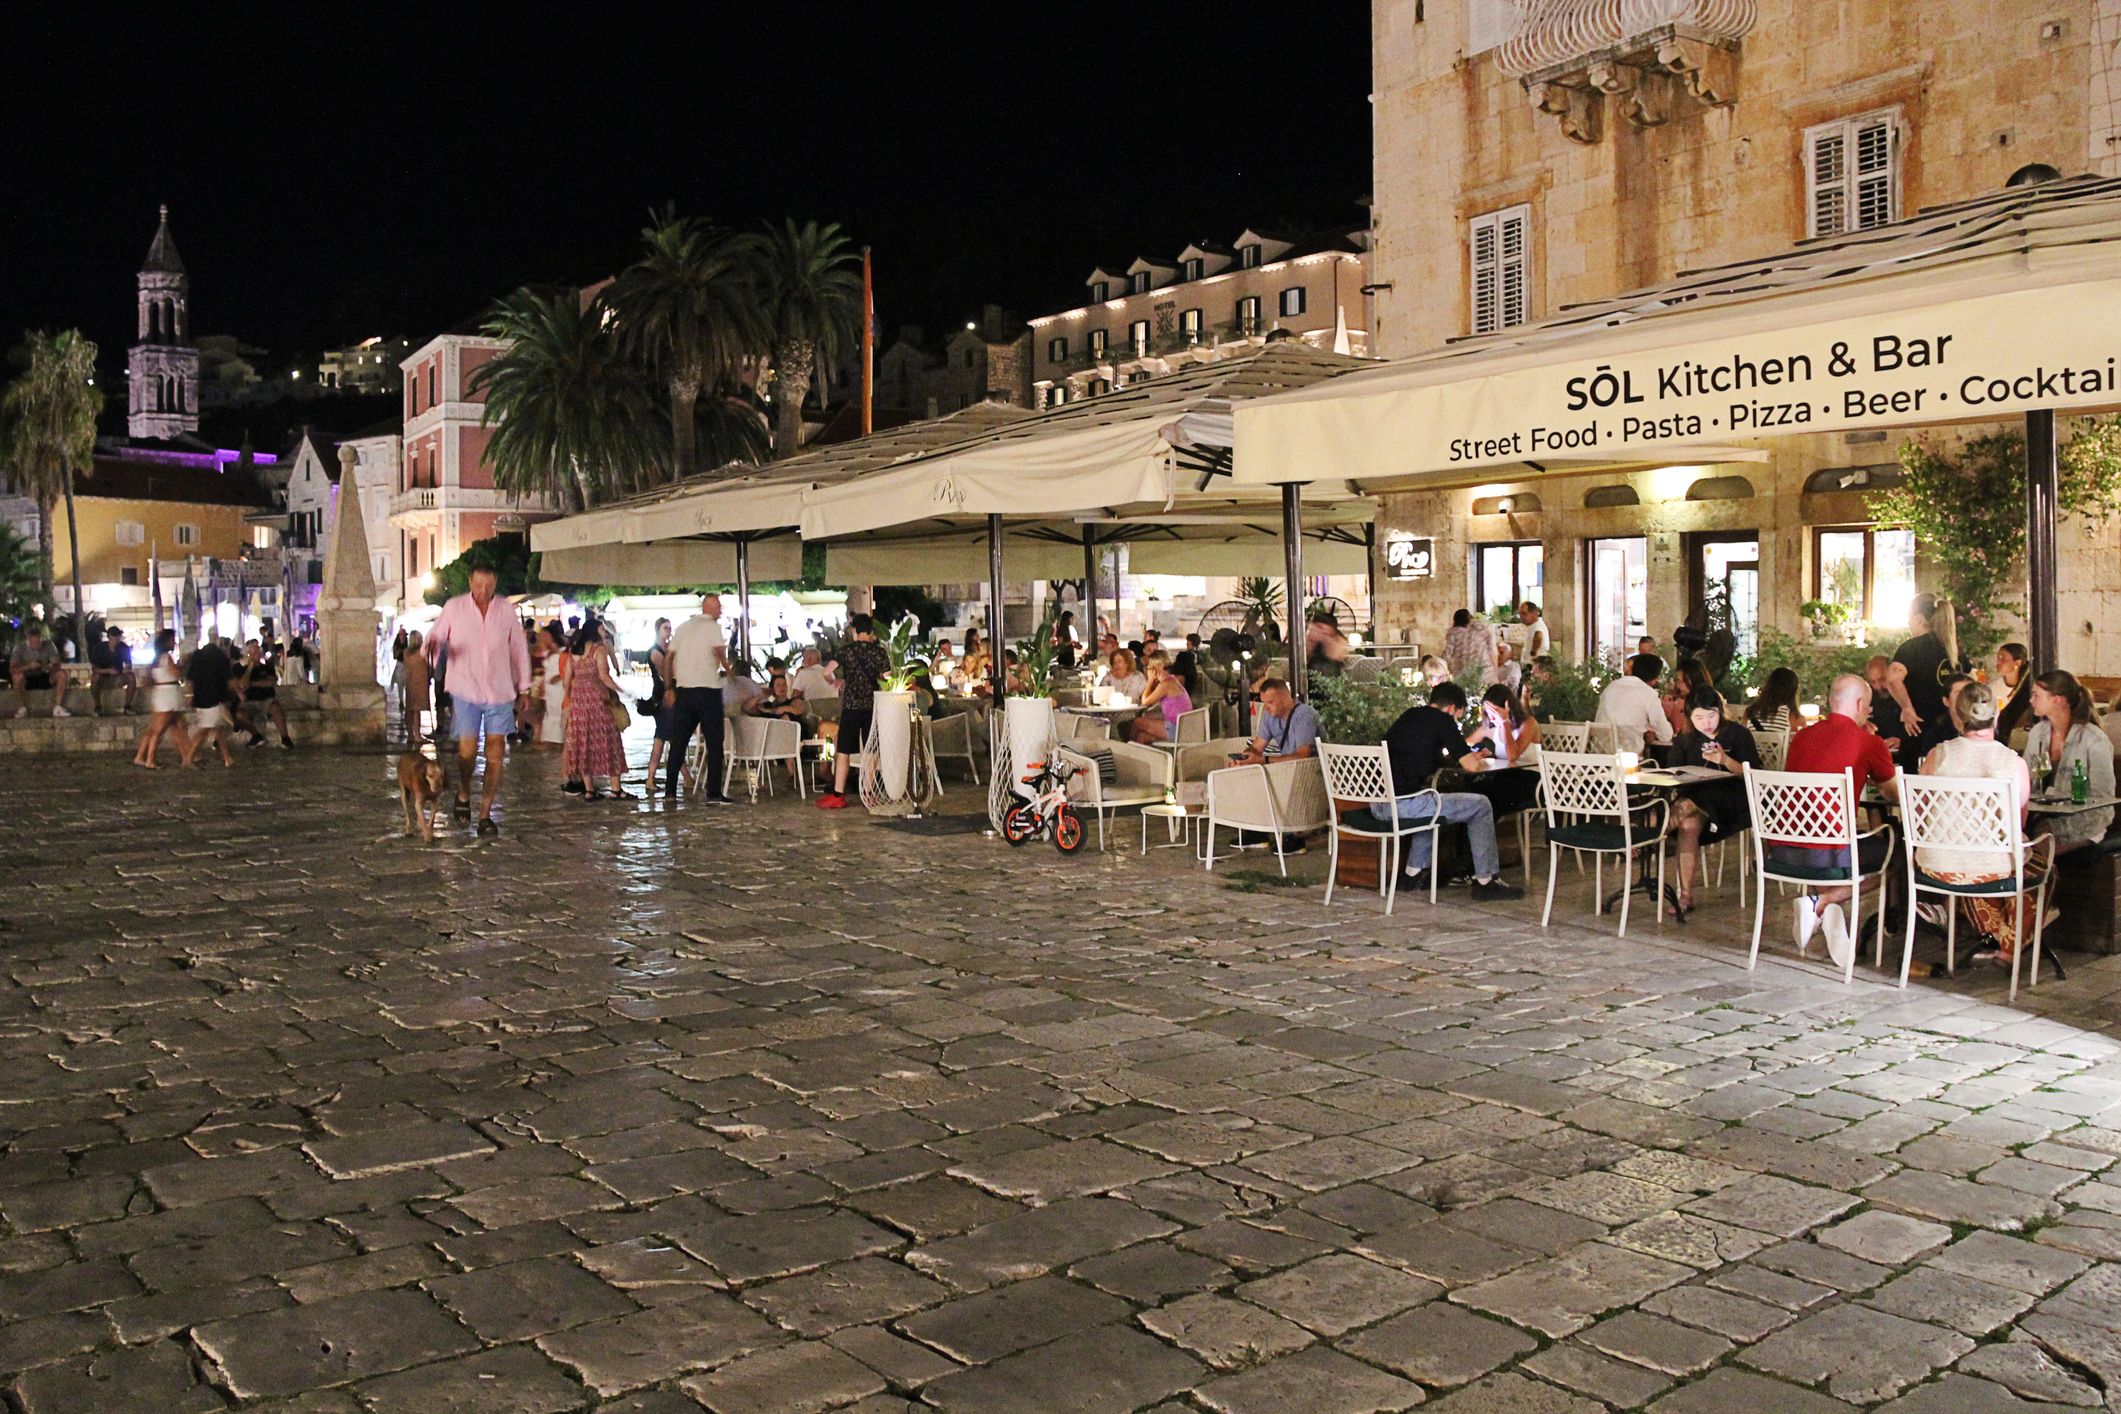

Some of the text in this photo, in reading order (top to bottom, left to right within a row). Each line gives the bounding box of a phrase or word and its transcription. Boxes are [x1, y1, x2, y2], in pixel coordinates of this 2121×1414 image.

[1154, 301, 1176, 310] HOTEL
[1566, 334, 1953, 411] SŌL Kitchen & Bar
[1449, 432, 1522, 462] Street
[1531, 420, 1597, 452] Food
[1623, 413, 1701, 443] Pasta
[1729, 399, 1812, 431] Pizza
[1843, 388, 1927, 418] Beer
